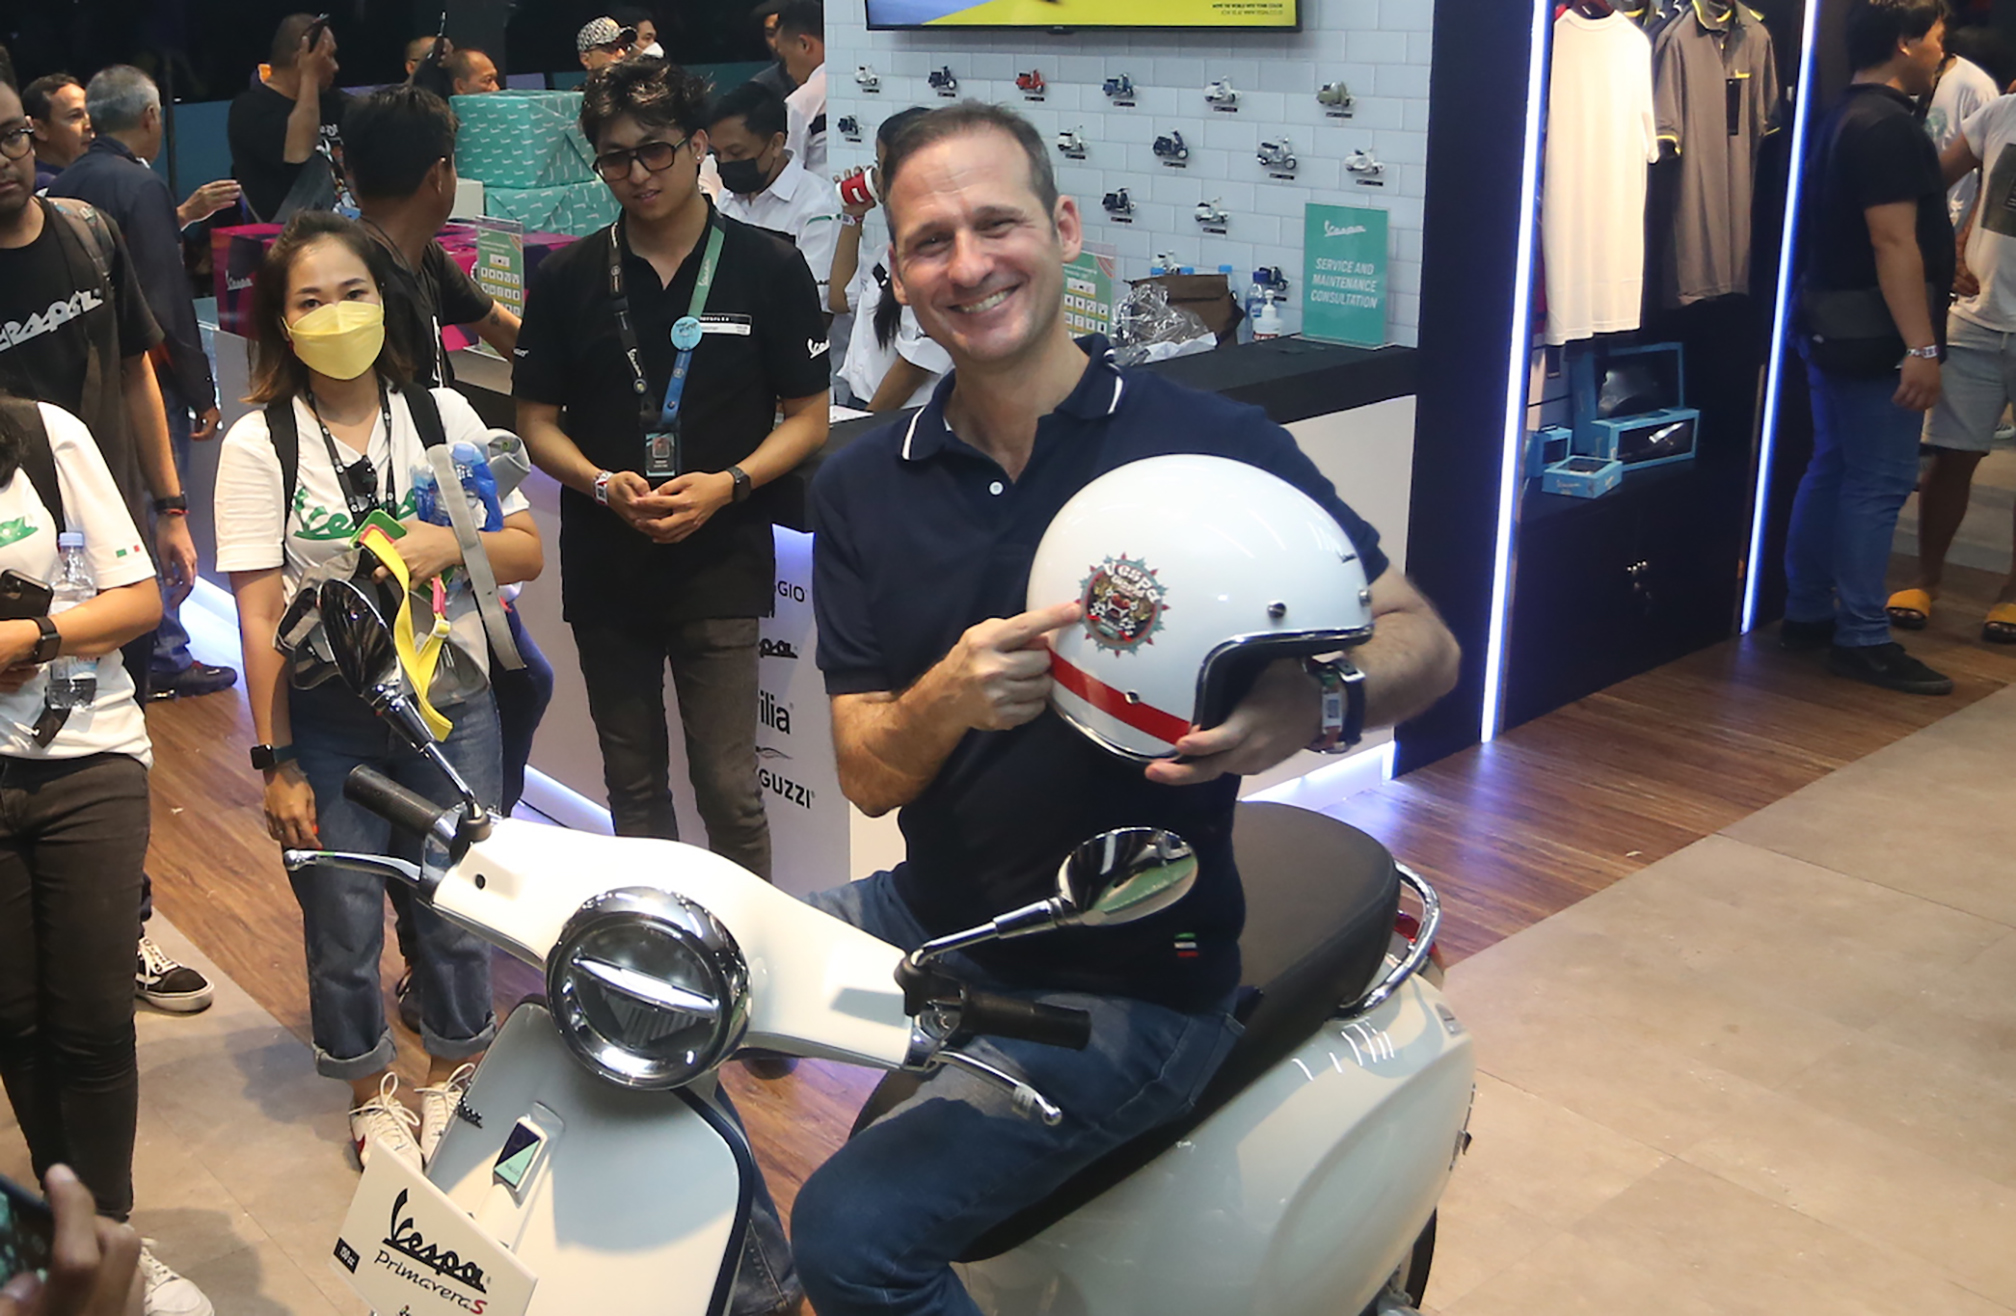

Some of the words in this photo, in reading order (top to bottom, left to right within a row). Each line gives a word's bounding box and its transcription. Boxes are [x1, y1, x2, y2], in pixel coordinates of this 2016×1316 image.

[1324, 219, 1366, 237] Vespa
[1316, 257, 1354, 273] SERVICE
[1354, 261, 1374, 275] AND
[1312, 273, 1378, 292] MAINTENANCE
[1310, 289, 1378, 309] CONSULTATION
[775, 580, 805, 602] GIO
[758, 768, 811, 809] GUZZI
[382, 1187, 487, 1295] Vespa
